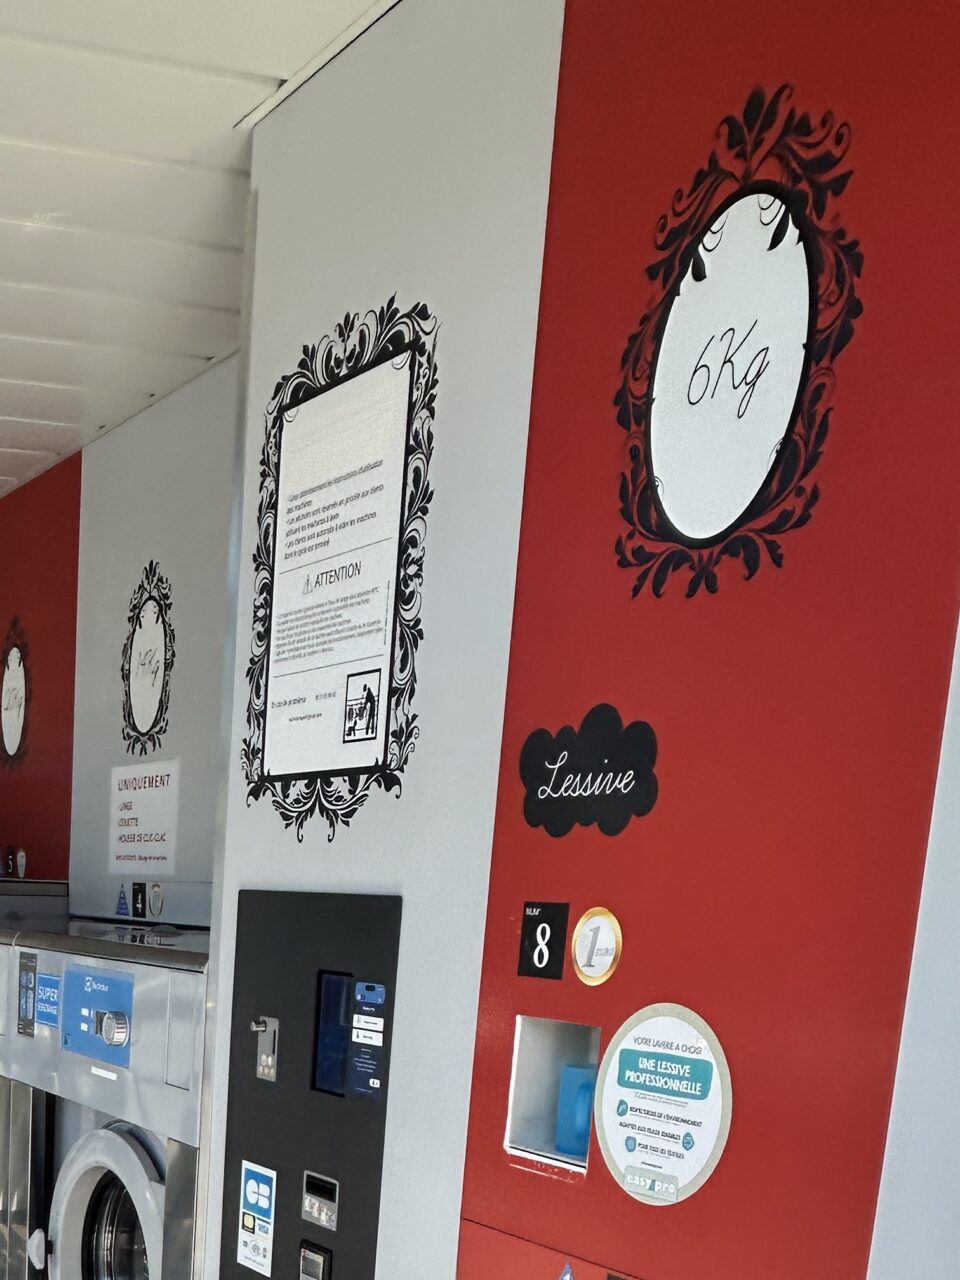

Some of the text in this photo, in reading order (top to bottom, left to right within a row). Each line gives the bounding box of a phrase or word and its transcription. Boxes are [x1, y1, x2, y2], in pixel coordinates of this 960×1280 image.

[686, 318, 771, 420] 6Kg
[314, 560, 362, 588] ATTENTION
[118, 774, 170, 791] UNIQUEMENT
[538, 751, 635, 799] Lessive
[136, 891, 143, 913] 4
[533, 923, 551, 968] 8
[581, 926, 601, 968] 1
[38, 986, 59, 1002] SUPER
[638, 1057, 691, 1078] UNE LESSIVE
[625, 1070, 703, 1095] PROFESSIONNELLE
